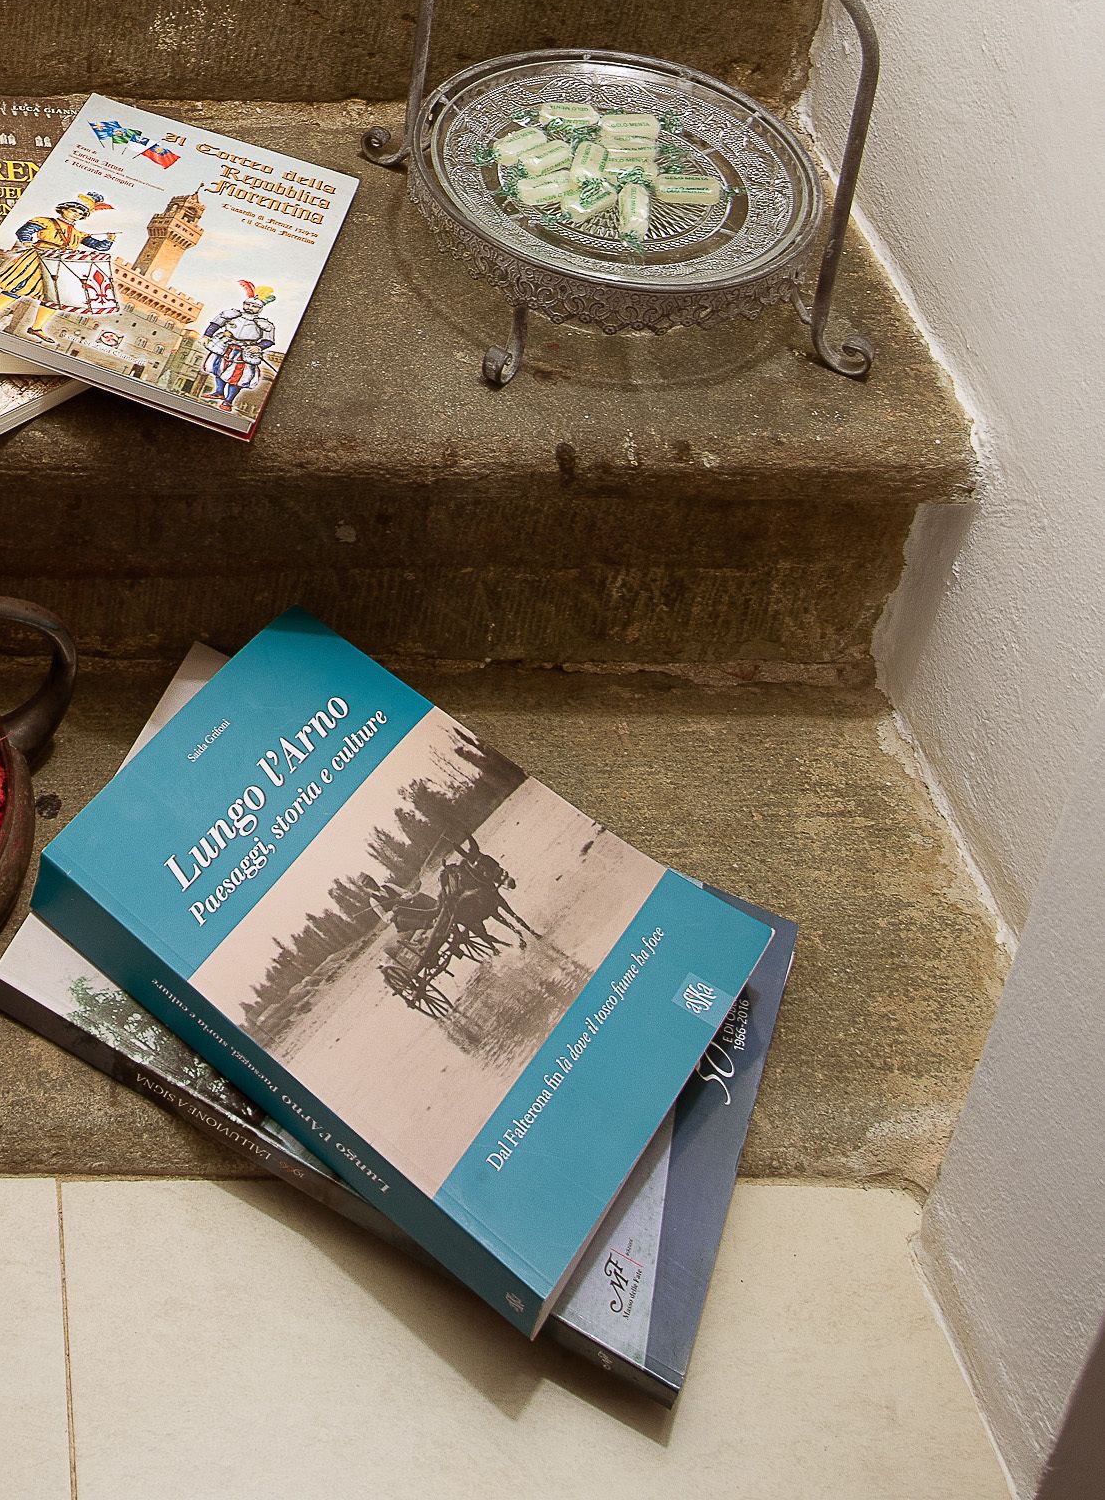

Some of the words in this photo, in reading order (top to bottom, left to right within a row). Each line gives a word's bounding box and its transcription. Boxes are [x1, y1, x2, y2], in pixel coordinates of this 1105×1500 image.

[12, 105, 40, 113] LUCA
[43, 107, 77, 115] GIANN
[71, 160, 103, 176] Riccardo
[196, 143, 274, 175] Corteo
[282, 170, 337, 195] della
[219, 164, 331, 210] Repubblica
[204, 179, 325, 225] Fiorentina
[254, 221, 277, 234] Calcio
[279, 230, 317, 245] Fiorentino
[187, 741, 209, 763] Saida
[204, 718, 231, 746] Grifoni
[163, 785, 266, 893] Lungo
[256, 696, 350, 788] l'Arno
[188, 836, 276, 927] Paesaggi,
[270, 781, 323, 840] storia
[320, 768, 334, 784] e
[330, 709, 388, 772] culture
[150, 978, 189, 1014] culture
[197, 1017, 229, 1048] storia
[733, 999, 750, 1051] 1966-2016
[230, 1044, 278, 1093] Paesaggi,
[485, 1140, 514, 1172] Dal
[502, 1087, 552, 1147] Falterona
[543, 1071, 565, 1094] fin
[555, 1056, 574, 1074] là
[566, 1030, 592, 1062] dove
[585, 1016, 599, 1036] il
[594, 993, 619, 1026] tosco
[610, 963, 639, 1001] fiume
[642, 926, 665, 956] foce
[135, 1072, 176, 1101] SIGNA
[175, 1097, 190, 1109] A
[186, 1102, 272, 1161] L'ALLUVIONE
[281, 1094, 331, 1143] l'Arno
[335, 1141, 392, 1195] Lungo
